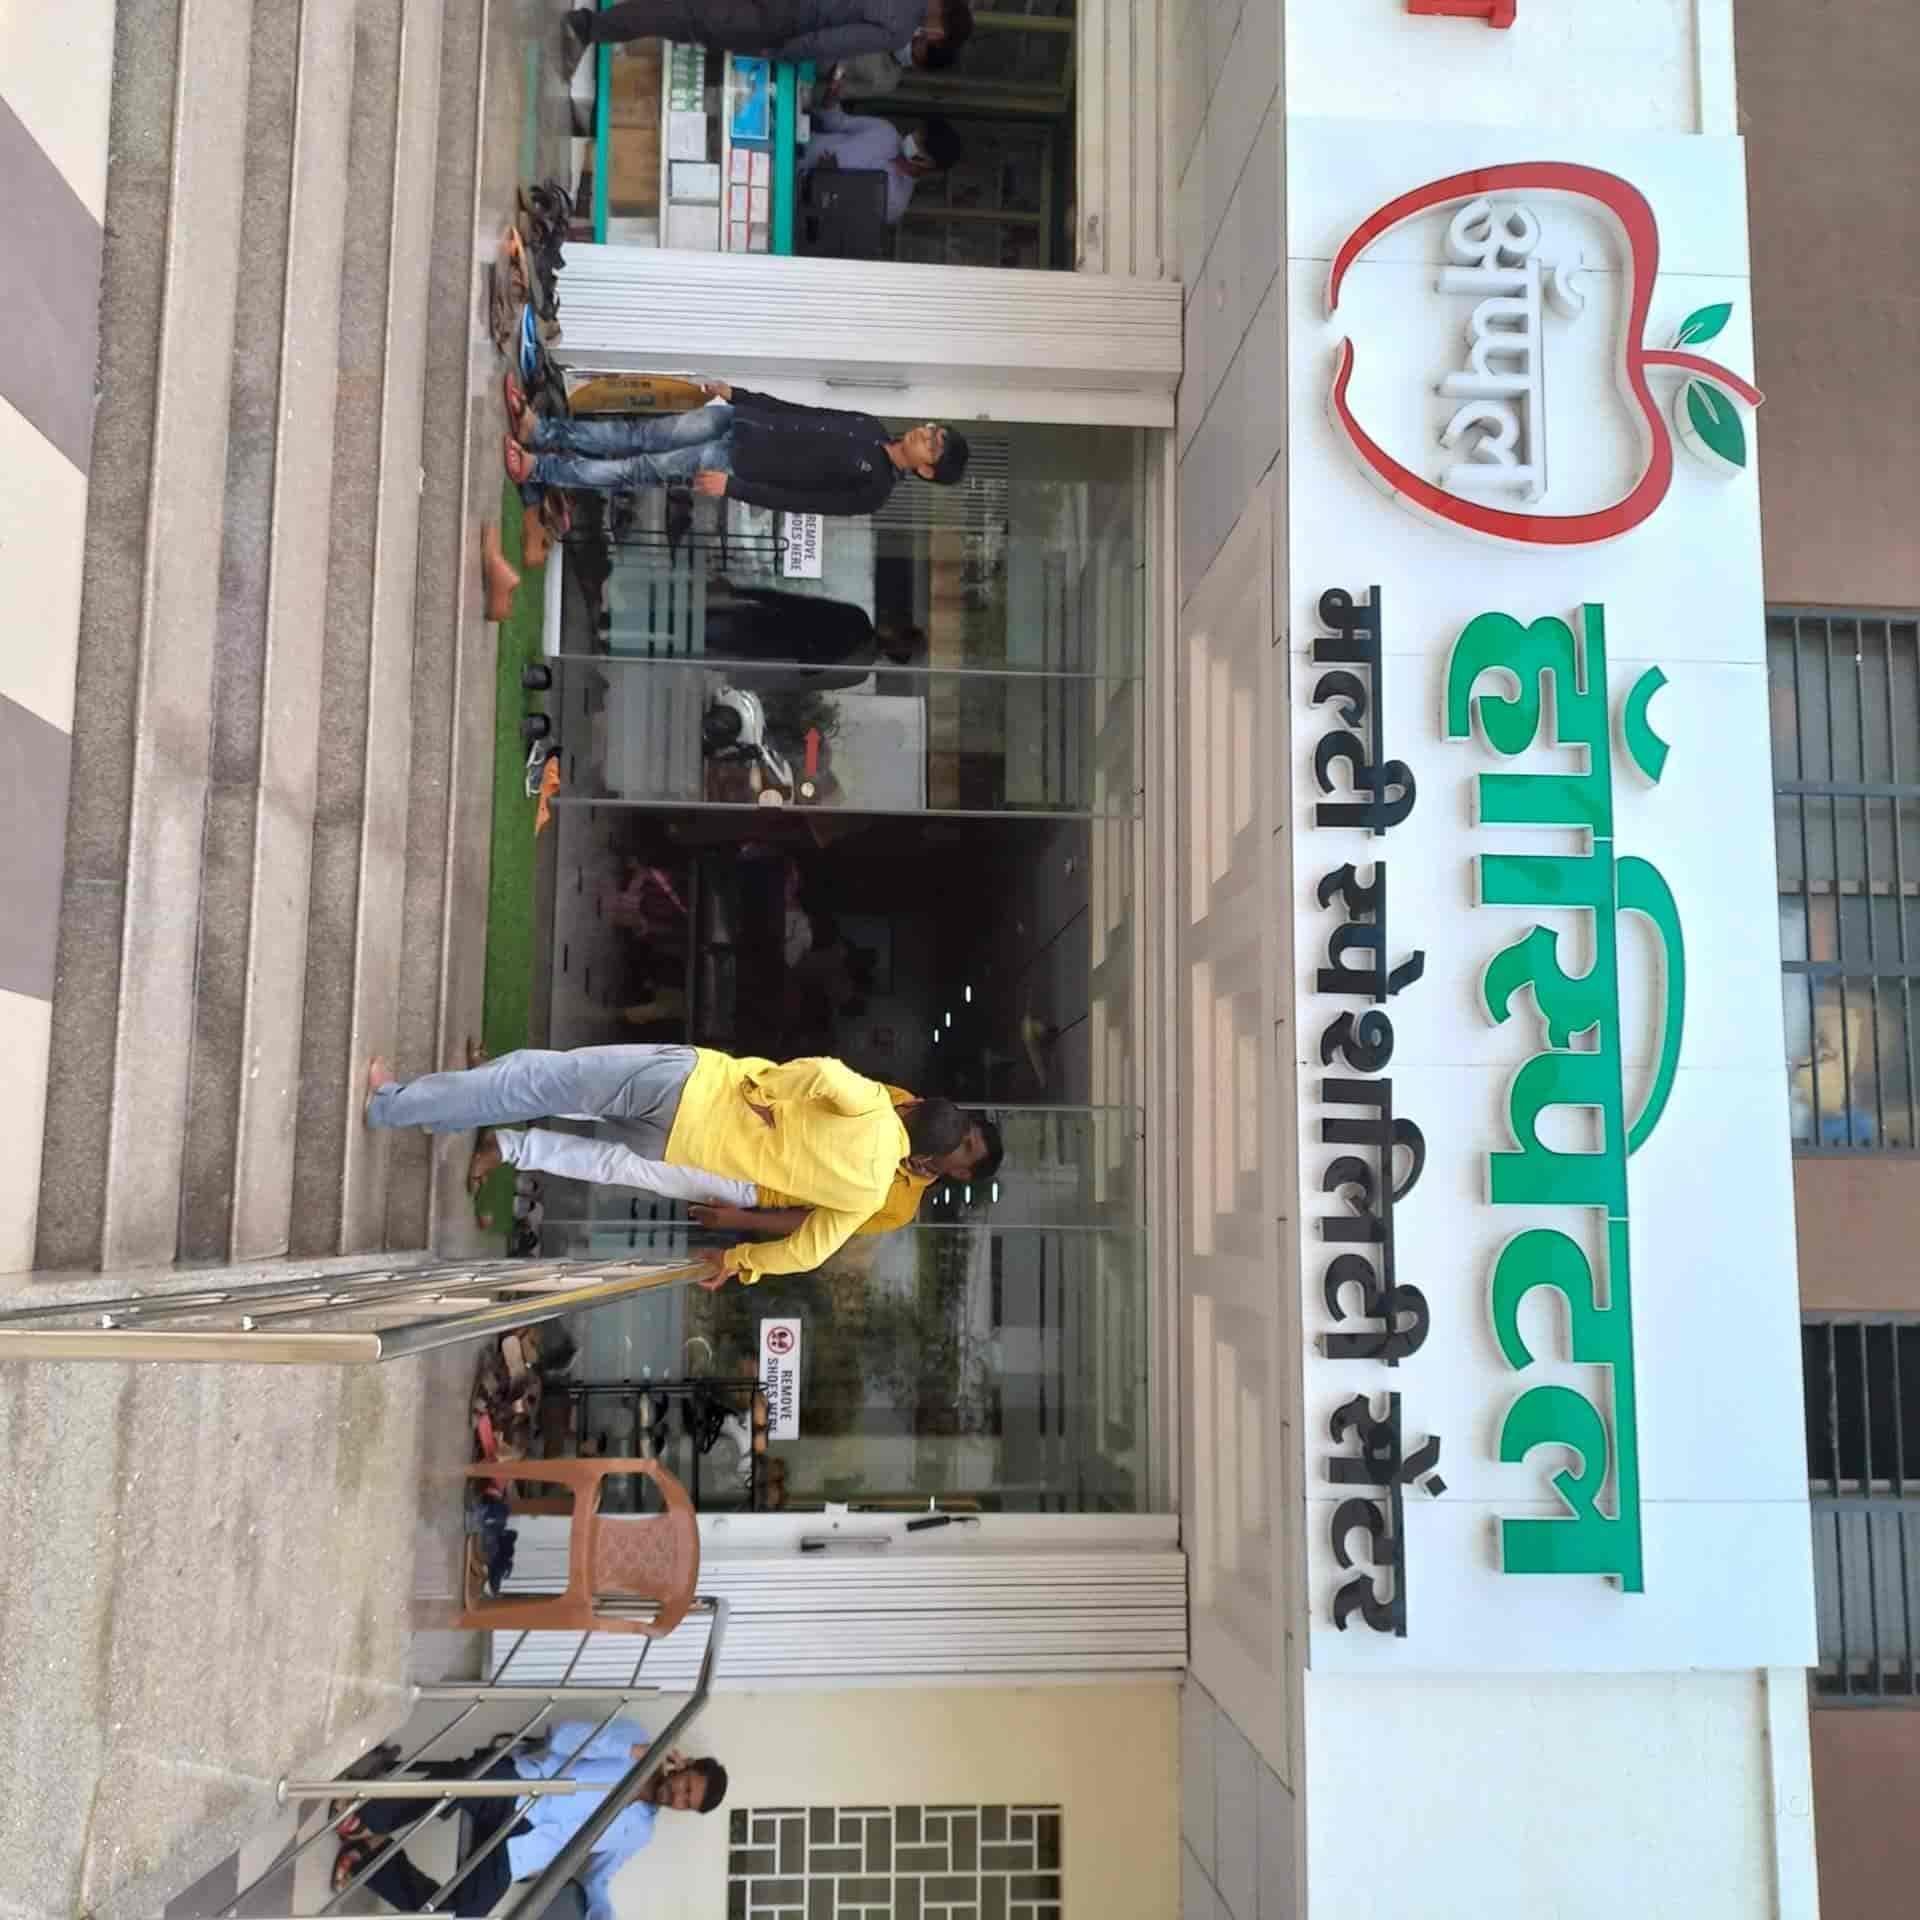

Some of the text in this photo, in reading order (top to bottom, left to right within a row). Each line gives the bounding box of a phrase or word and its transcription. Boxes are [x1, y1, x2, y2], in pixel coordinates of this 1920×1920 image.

[790, 512, 803, 571] HOES HERE
[804, 516, 817, 561] REMOVE
[1311, 585, 1447, 1638] मल्टी स्पेशलिटी सेंटर
[1442, 603, 1687, 1593] हॉस्पिटल
[767, 1358, 779, 1399] SHOES
[779, 1370, 793, 1422] REMOVE
